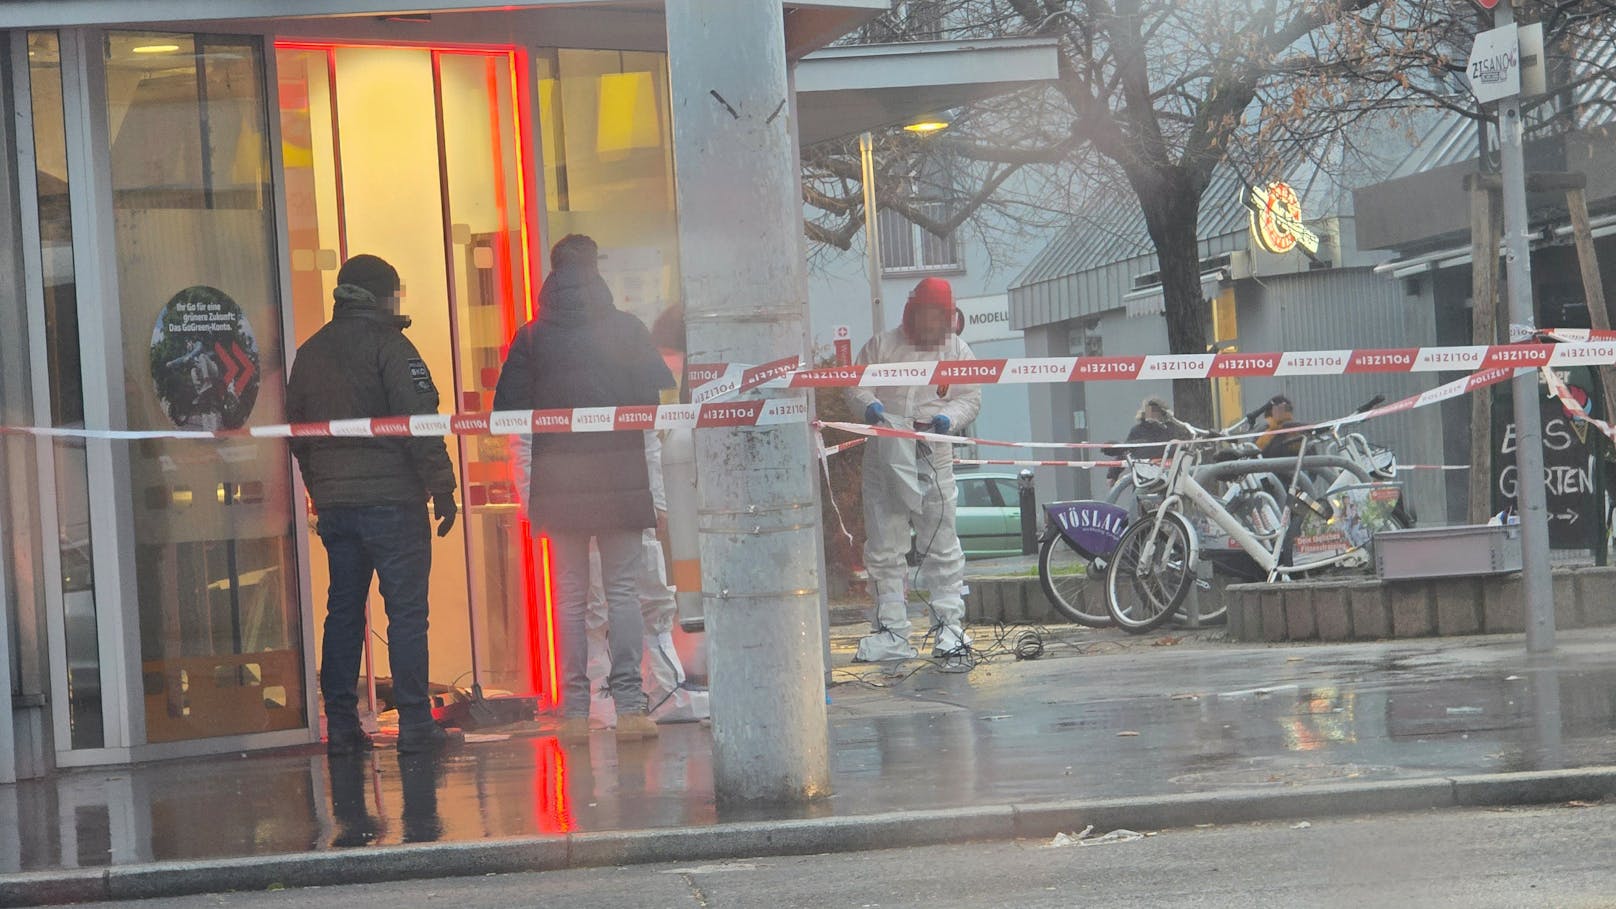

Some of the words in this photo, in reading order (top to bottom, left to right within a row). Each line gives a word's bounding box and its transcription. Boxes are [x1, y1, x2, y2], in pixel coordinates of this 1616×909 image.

[187, 303, 196, 311] Go
[197, 303, 206, 311] für
[207, 303, 221, 311] eine
[183, 313, 208, 323] grünere
[169, 324, 181, 332] Das
[879, 368, 927, 377] POLIZEI
[947, 366, 997, 376] POLIZEI
[1019, 364, 1067, 374] POLIZEI
[1087, 363, 1136, 373] POLIZEI
[1156, 361, 1204, 371] POLIZEI
[1225, 359, 1274, 369] POLIZEI
[1294, 357, 1342, 367] POLIZEI
[1361, 355, 1410, 365] POLIZEI
[1431, 353, 1479, 362] POLIZEI
[1498, 350, 1547, 361] POLIZEI
[1567, 348, 1614, 358] POLIZEI
[1470, 369, 1505, 386] POLIZEI
[697, 382, 735, 402] POLIZEI
[540, 416, 570, 426] POLIZEI
[581, 414, 611, 424] POLIZEI
[623, 413, 653, 423] POLIZEI
[666, 410, 695, 420] POLIZEI
[709, 408, 754, 419] POLIZEI
[1501, 419, 1572, 454] ES
[1499, 453, 1596, 499] GRTEN
